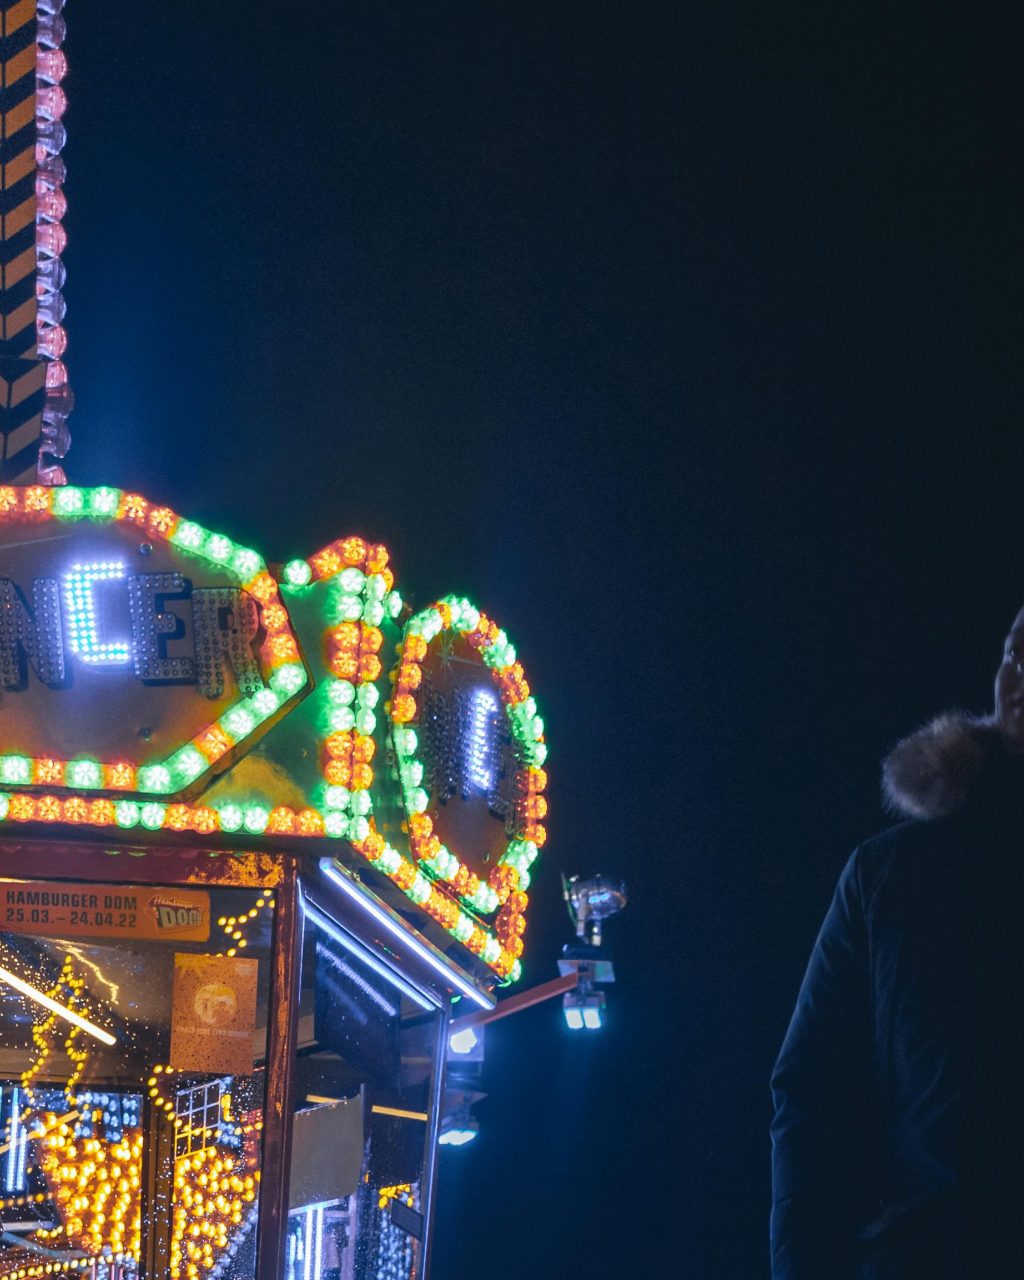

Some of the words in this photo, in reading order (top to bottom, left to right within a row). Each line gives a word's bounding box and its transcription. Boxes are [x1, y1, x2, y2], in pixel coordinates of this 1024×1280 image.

[6, 891, 97, 908] HAMBURGER
[104, 895, 138, 911] DOM
[70, 911, 137, 928] 24.04.22
